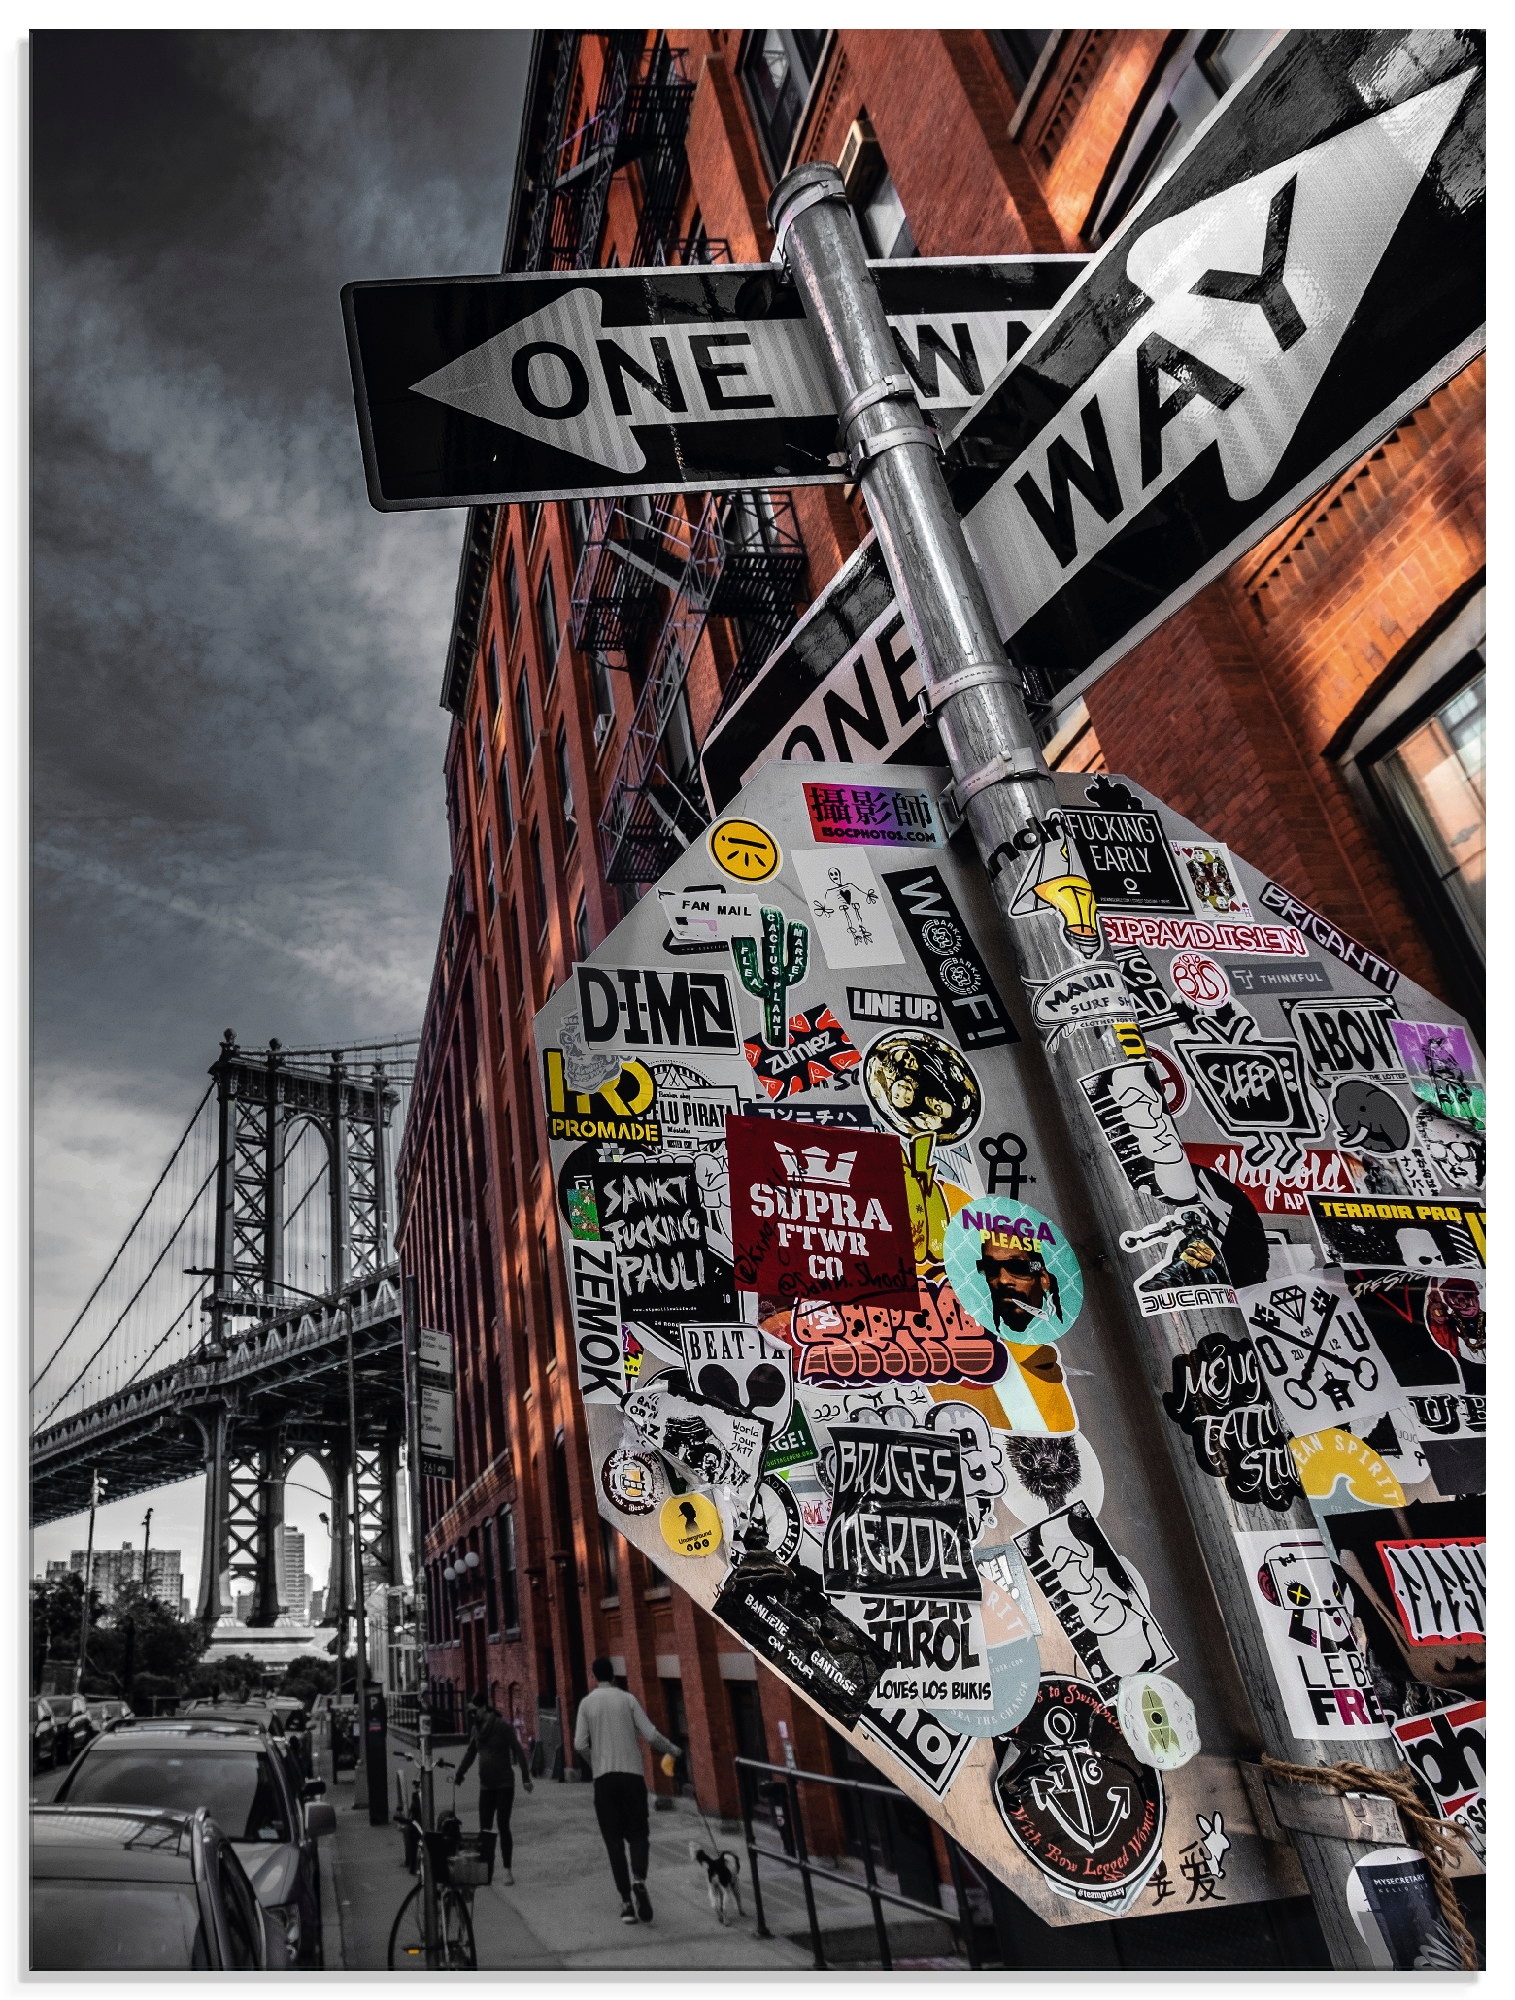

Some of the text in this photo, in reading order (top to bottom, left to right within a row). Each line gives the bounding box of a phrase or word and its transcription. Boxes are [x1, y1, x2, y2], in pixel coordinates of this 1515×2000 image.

[511, 331, 775, 421] ONE
[1014, 172, 1307, 568] WAY
[811, 787, 932, 827] 攝影師
[1068, 814, 1155, 844] FUCKING
[1089, 845, 1152, 874] EARLY
[681, 899, 752, 917] FAN MAIL
[788, 929, 804, 982] MARKET
[1262, 884, 1399, 991] BRIGANTI
[741, 947, 758, 986] FLEA
[767, 914, 783, 1037] CACTUS PLANT
[1259, 973, 1323, 985] THINKFUL
[852, 990, 938, 1022] LINE UP.
[1044, 973, 1116, 1012] MAUI
[1070, 996, 1111, 1015] SURF
[765, 1030, 838, 1076] zumiez
[1208, 1060, 1276, 1104] SLEEP
[552, 1118, 659, 1142] PROMADE
[603, 1174, 691, 1218] SANKT
[750, 1182, 893, 1232] SUPRA
[1320, 1200, 1463, 1222] TERROIR PRO
[603, 1209, 701, 1253] FUCKING
[777, 1222, 870, 1257] FTWR
[961, 1208, 1057, 1246] NIGGA
[978, 1229, 1043, 1255] PLEASE
[616, 1250, 706, 1297] PAULI
[808, 1254, 844, 1281] CO
[573, 1242, 625, 1401] ZEMOK
[732, 1430, 757, 1448] Tour
[764, 1475, 786, 1496] ADE
[837, 1440, 957, 1501] BRUGES
[1335, 1435, 1401, 1500] SPIRIT
[826, 1512, 968, 1581] MERDA
[767, 1635, 815, 1680] ON TOUR
[867, 1619, 980, 1673] TAROL
[876, 1679, 992, 1701] LOVES LOS BUKIS
[1044, 1843, 1079, 1874] Bow
[1082, 1845, 1130, 1882] Legged
